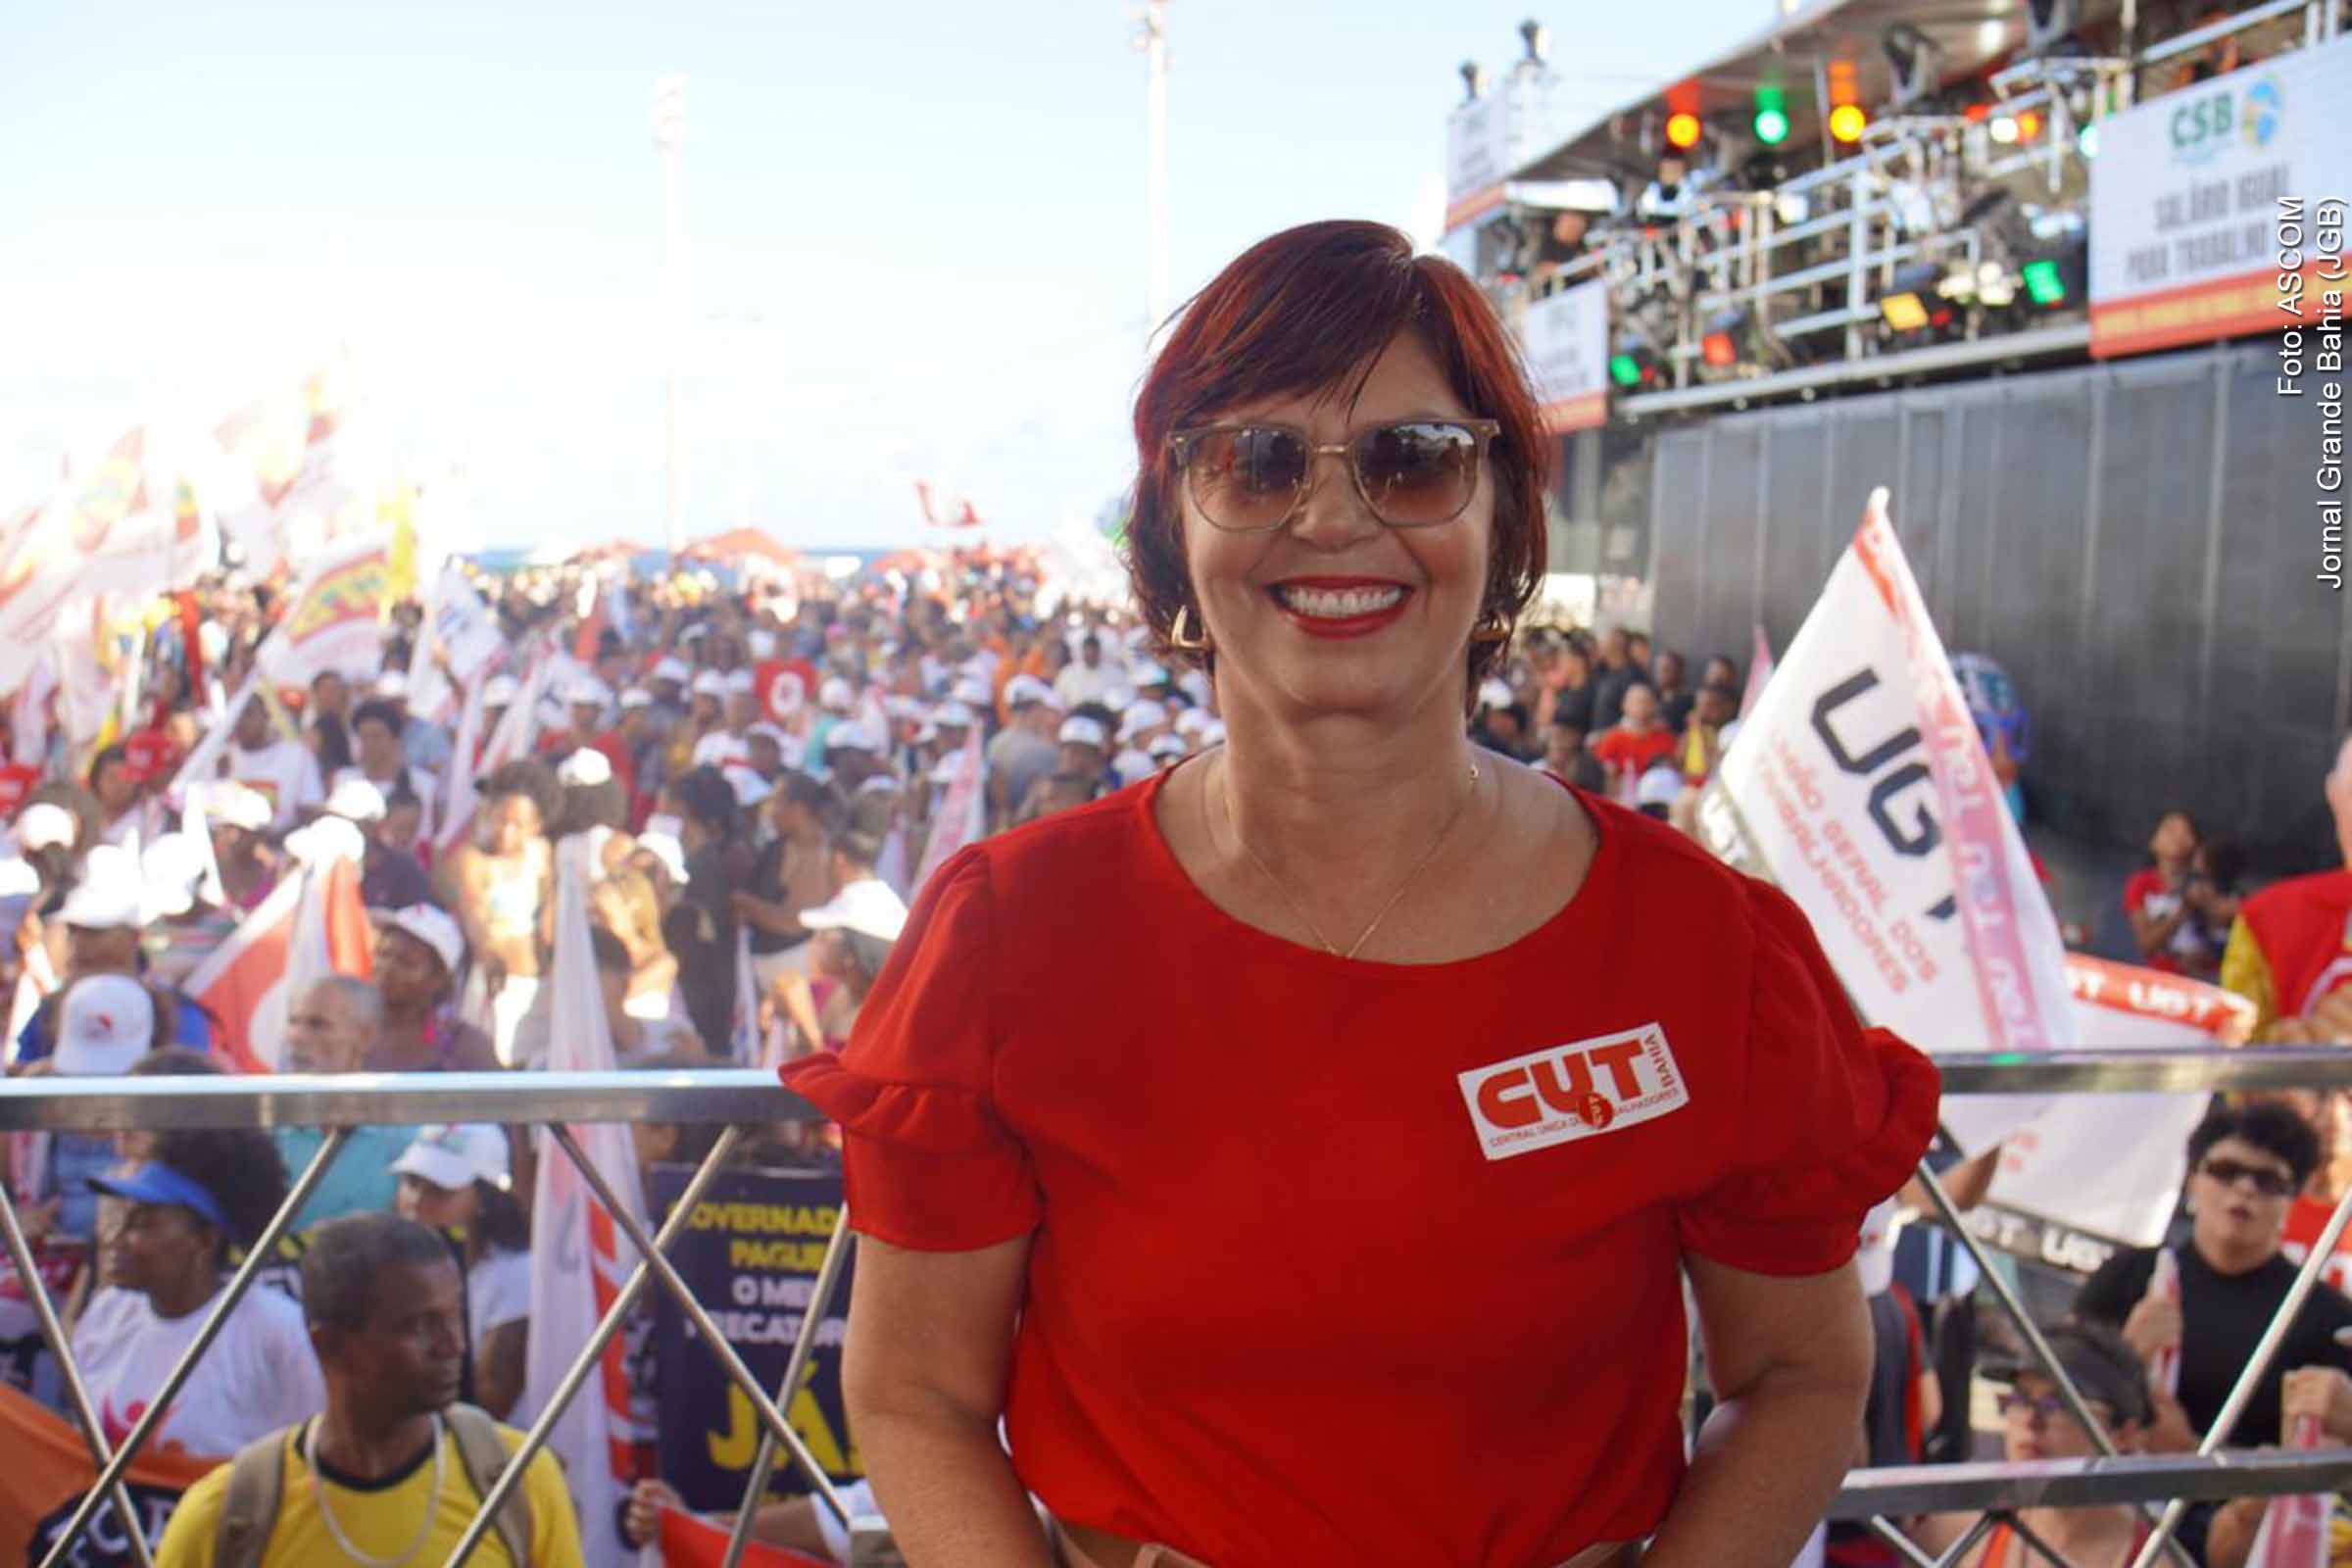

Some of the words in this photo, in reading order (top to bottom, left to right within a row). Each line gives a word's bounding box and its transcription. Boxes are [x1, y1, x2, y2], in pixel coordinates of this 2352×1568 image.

[2171, 92, 2234, 147] CSB
[1811, 666, 1957, 919] UG
[1477, 1039, 1644, 1129] CUT
[1644, 1032, 1677, 1090] BAHIA
[732, 1274, 759, 1306] O
